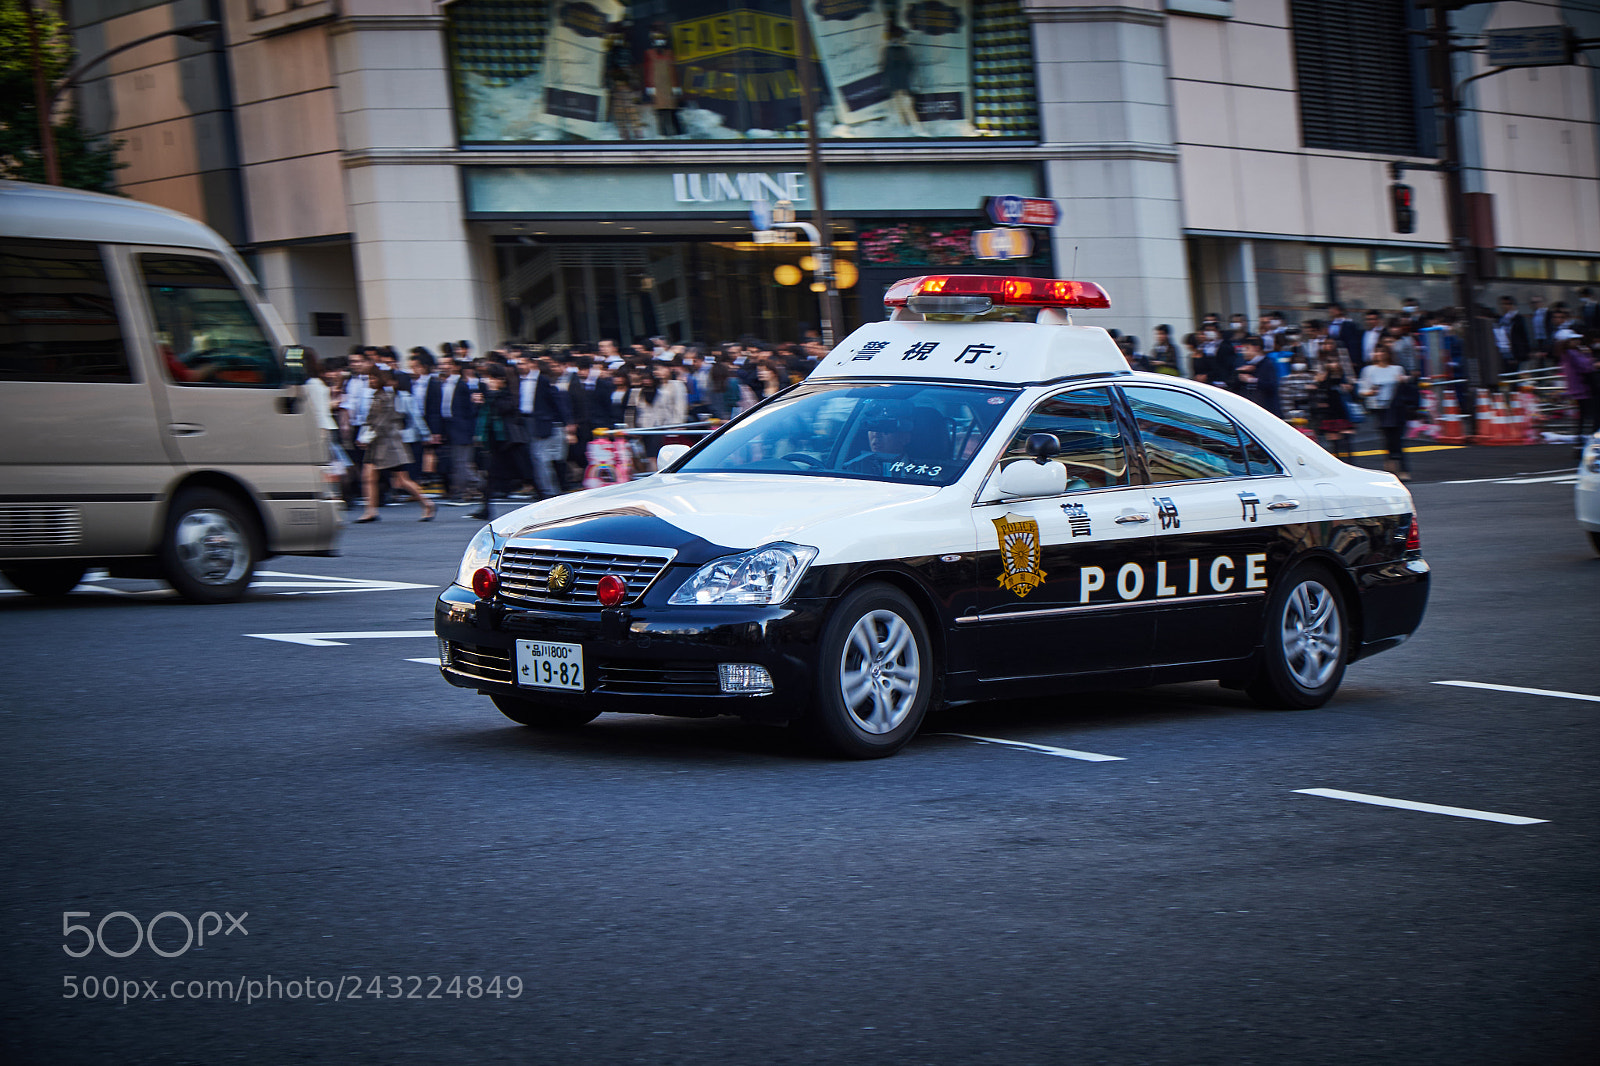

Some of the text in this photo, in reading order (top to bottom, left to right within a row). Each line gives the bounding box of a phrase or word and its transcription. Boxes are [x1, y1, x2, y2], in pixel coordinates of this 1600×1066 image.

[672, 13, 819, 60] FASHIO
[672, 172, 806, 202] LUMINE
[851, 341, 996, 364] 警視庁
[889, 461, 943, 477] 代々木3
[1001, 521, 1036, 534] POLICE
[1060, 490, 1260, 537] 警視庁
[1080, 554, 1268, 603] POLICE
